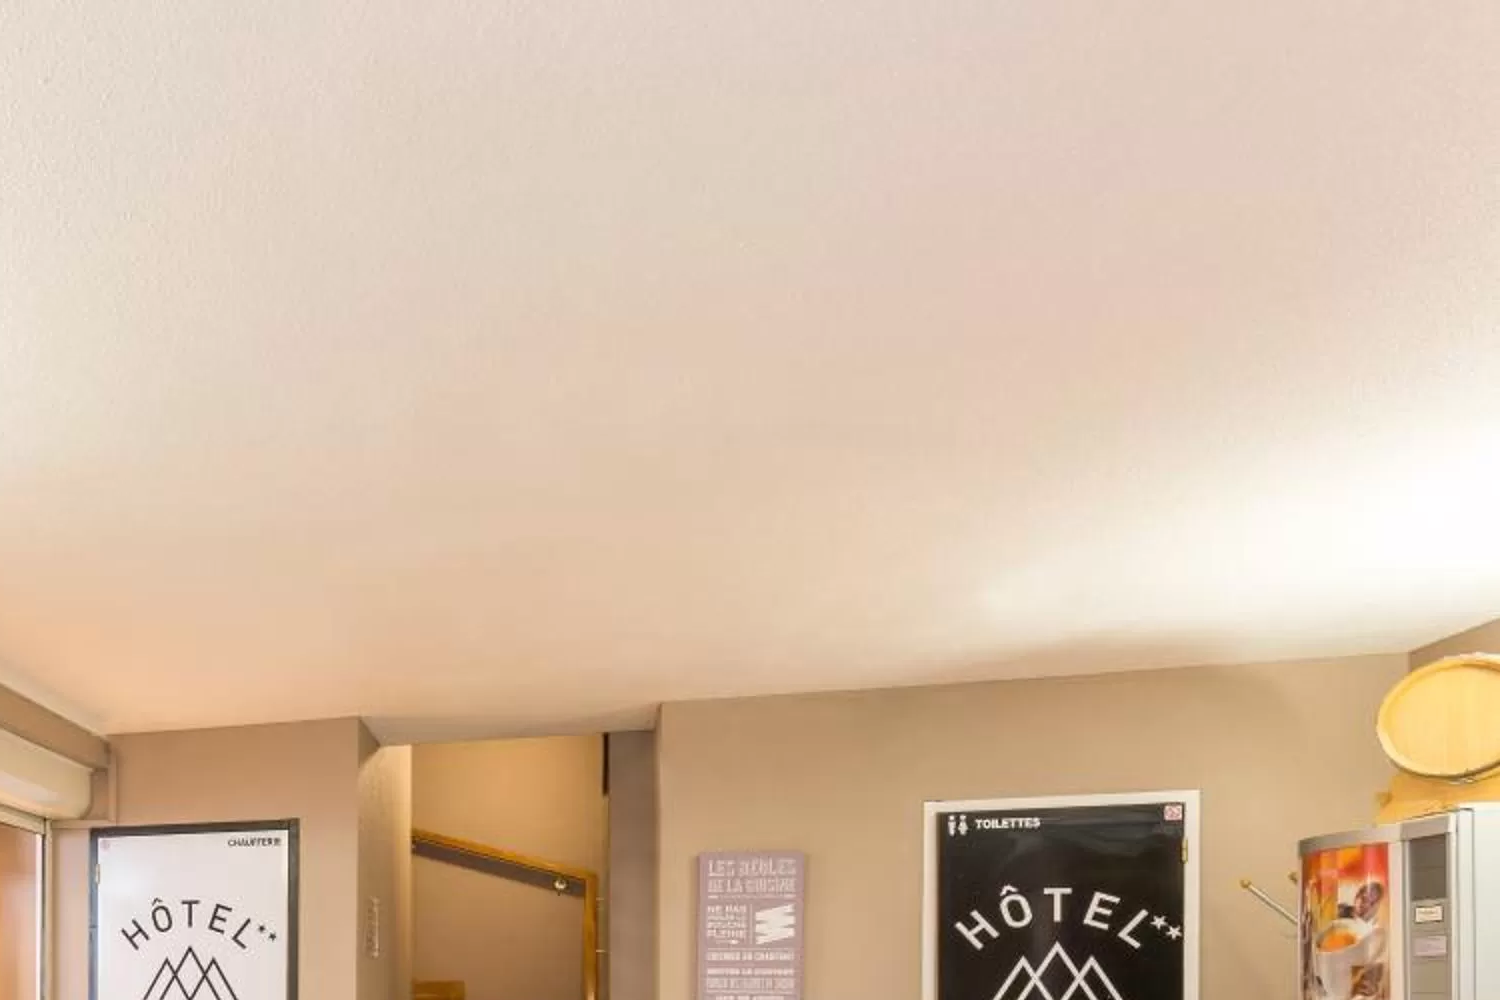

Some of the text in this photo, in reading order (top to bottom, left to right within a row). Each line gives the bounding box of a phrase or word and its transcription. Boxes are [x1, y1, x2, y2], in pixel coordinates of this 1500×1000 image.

[975, 817, 1041, 830] TOILETTES
[121, 897, 251, 950] HÔTEL
[955, 884, 1149, 951] HÔTEL
